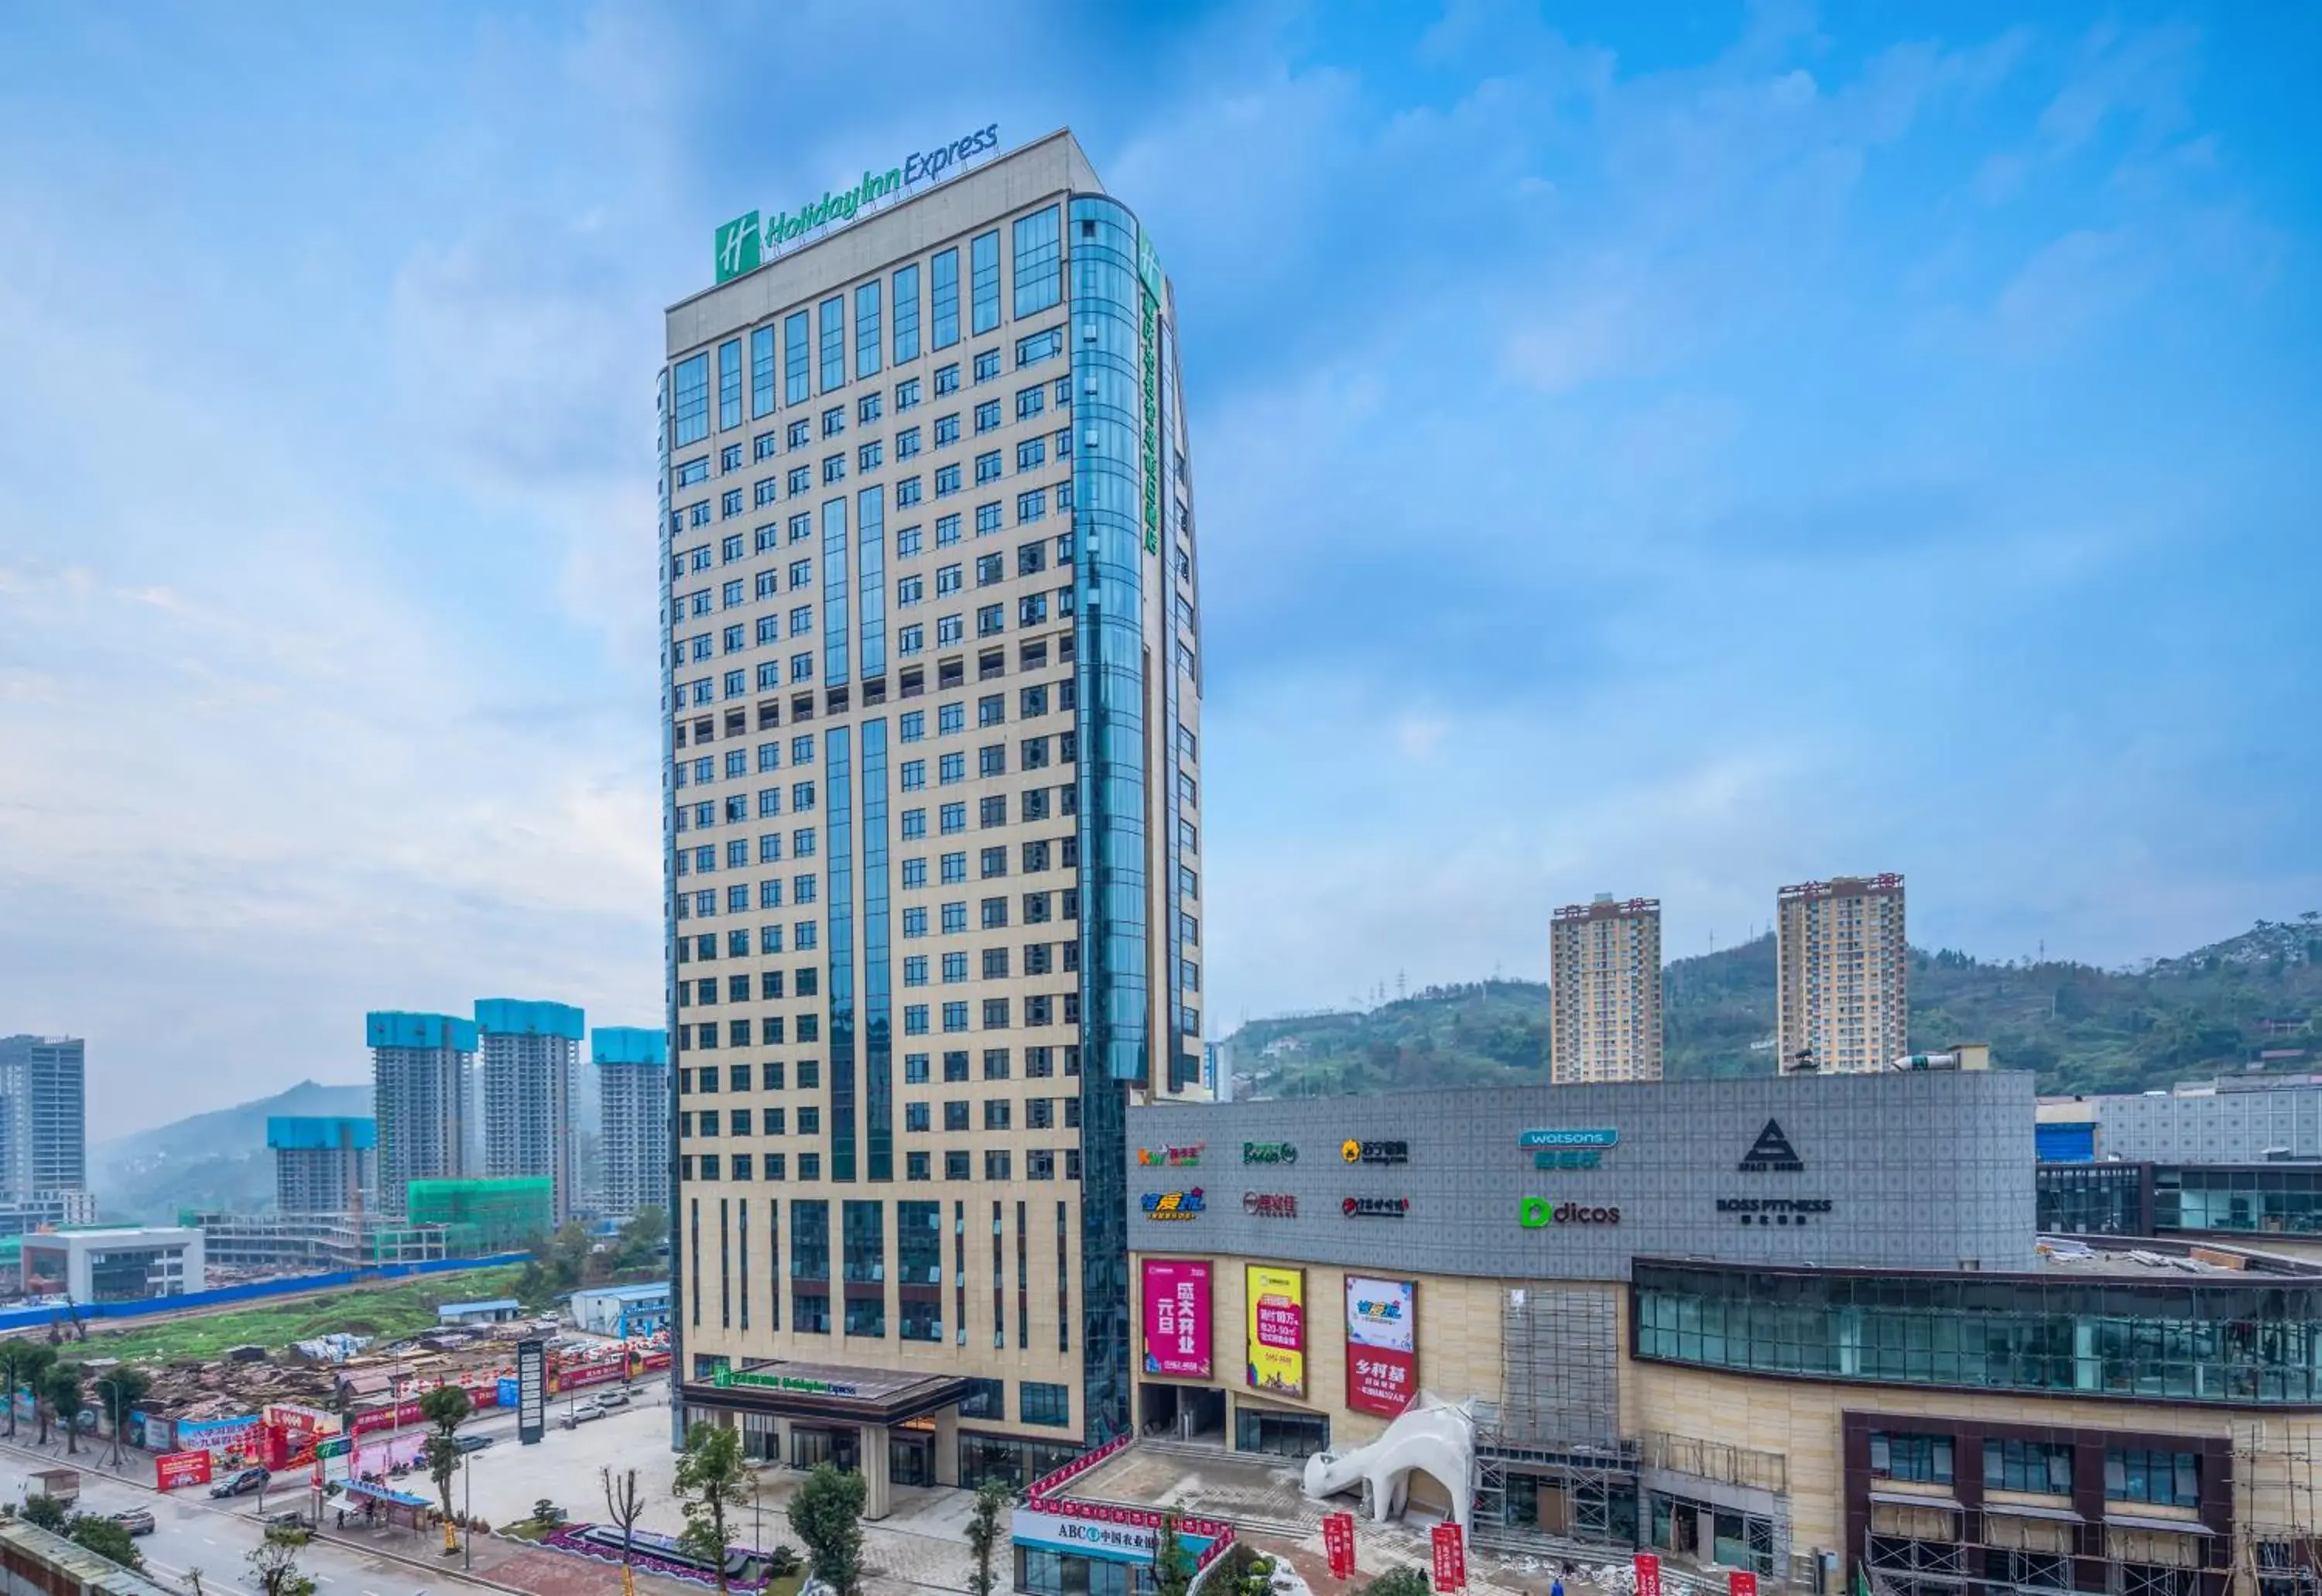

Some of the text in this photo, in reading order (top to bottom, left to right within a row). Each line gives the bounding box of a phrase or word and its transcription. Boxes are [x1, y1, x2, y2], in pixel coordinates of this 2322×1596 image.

[902, 123, 998, 186] Express
[1531, 1133, 1605, 1144] watsons
[1553, 1202, 1621, 1224] dicos
[1717, 1199, 1832, 1213] BOSS FITNESS
[1157, 1298, 1175, 1334] 元旦
[1355, 1358, 1406, 1382] 乡村基
[1058, 1523, 1086, 1539] ABC
